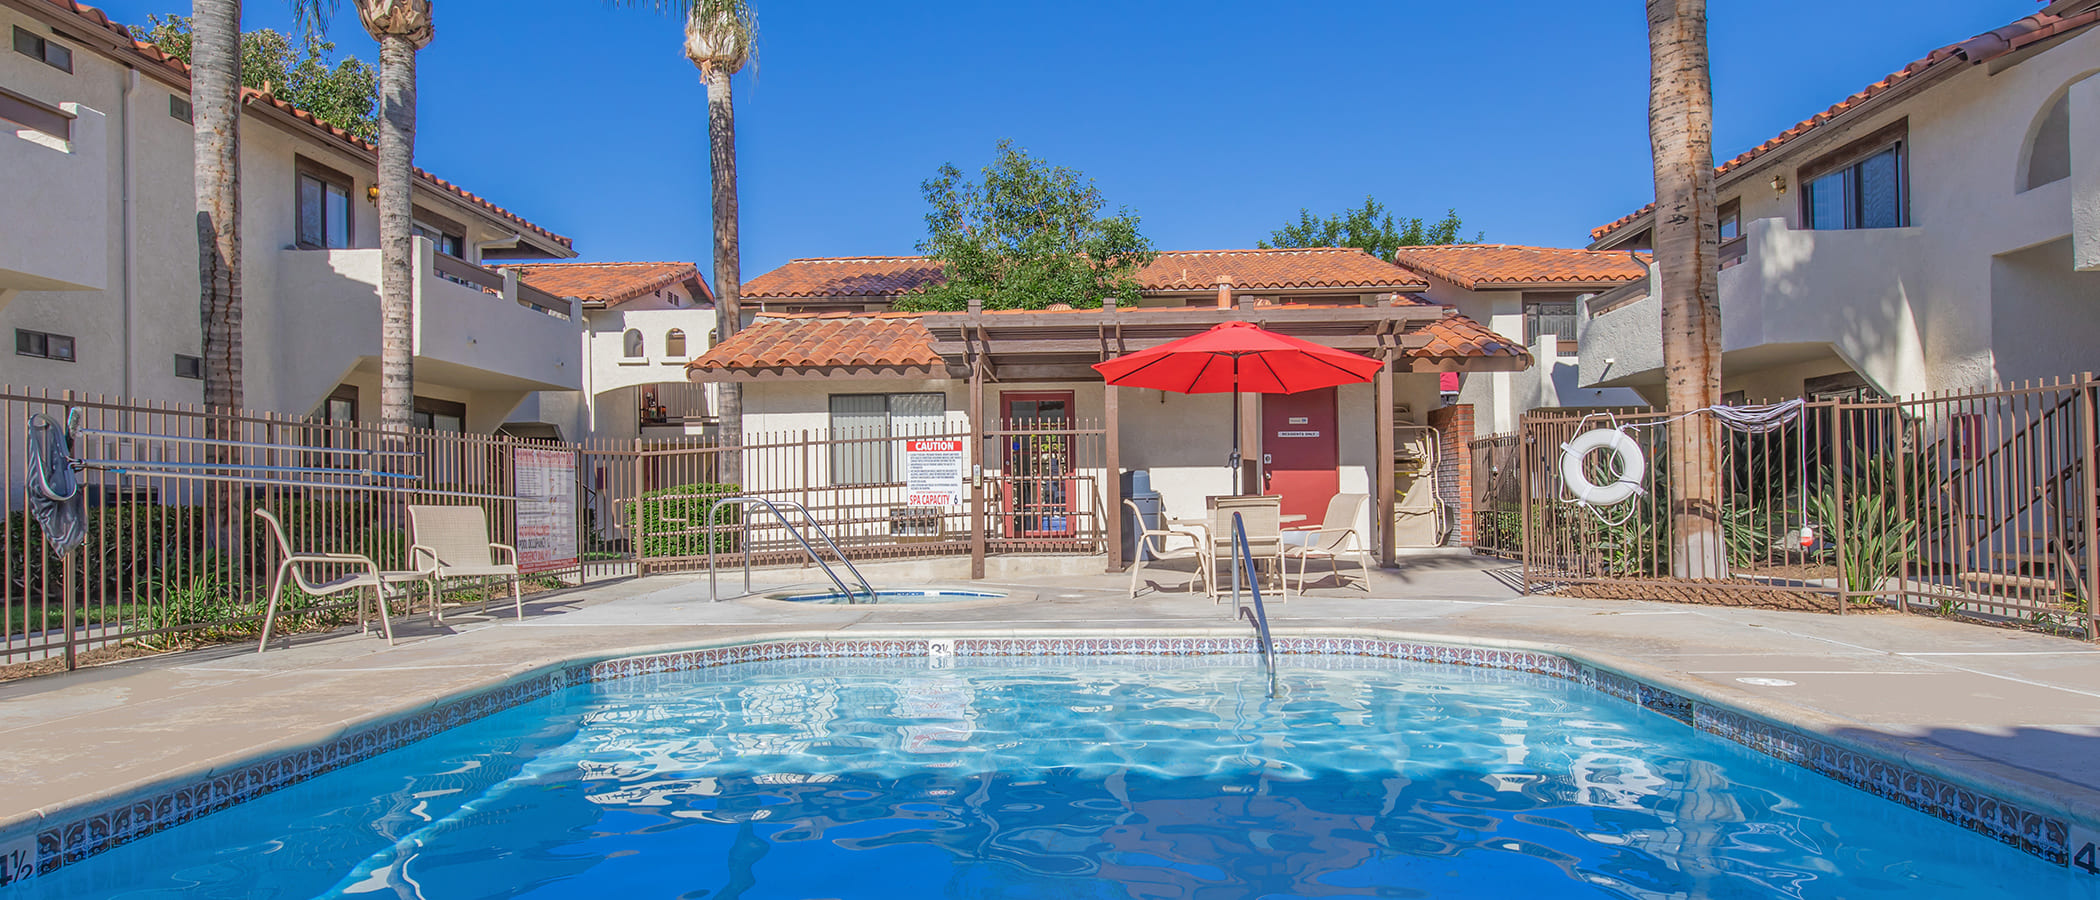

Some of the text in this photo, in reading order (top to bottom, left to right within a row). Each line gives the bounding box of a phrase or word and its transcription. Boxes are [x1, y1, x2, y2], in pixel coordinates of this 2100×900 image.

[915, 441, 954, 451] CAUTION
[910, 494, 959, 505] SPA CAPACITY 6
